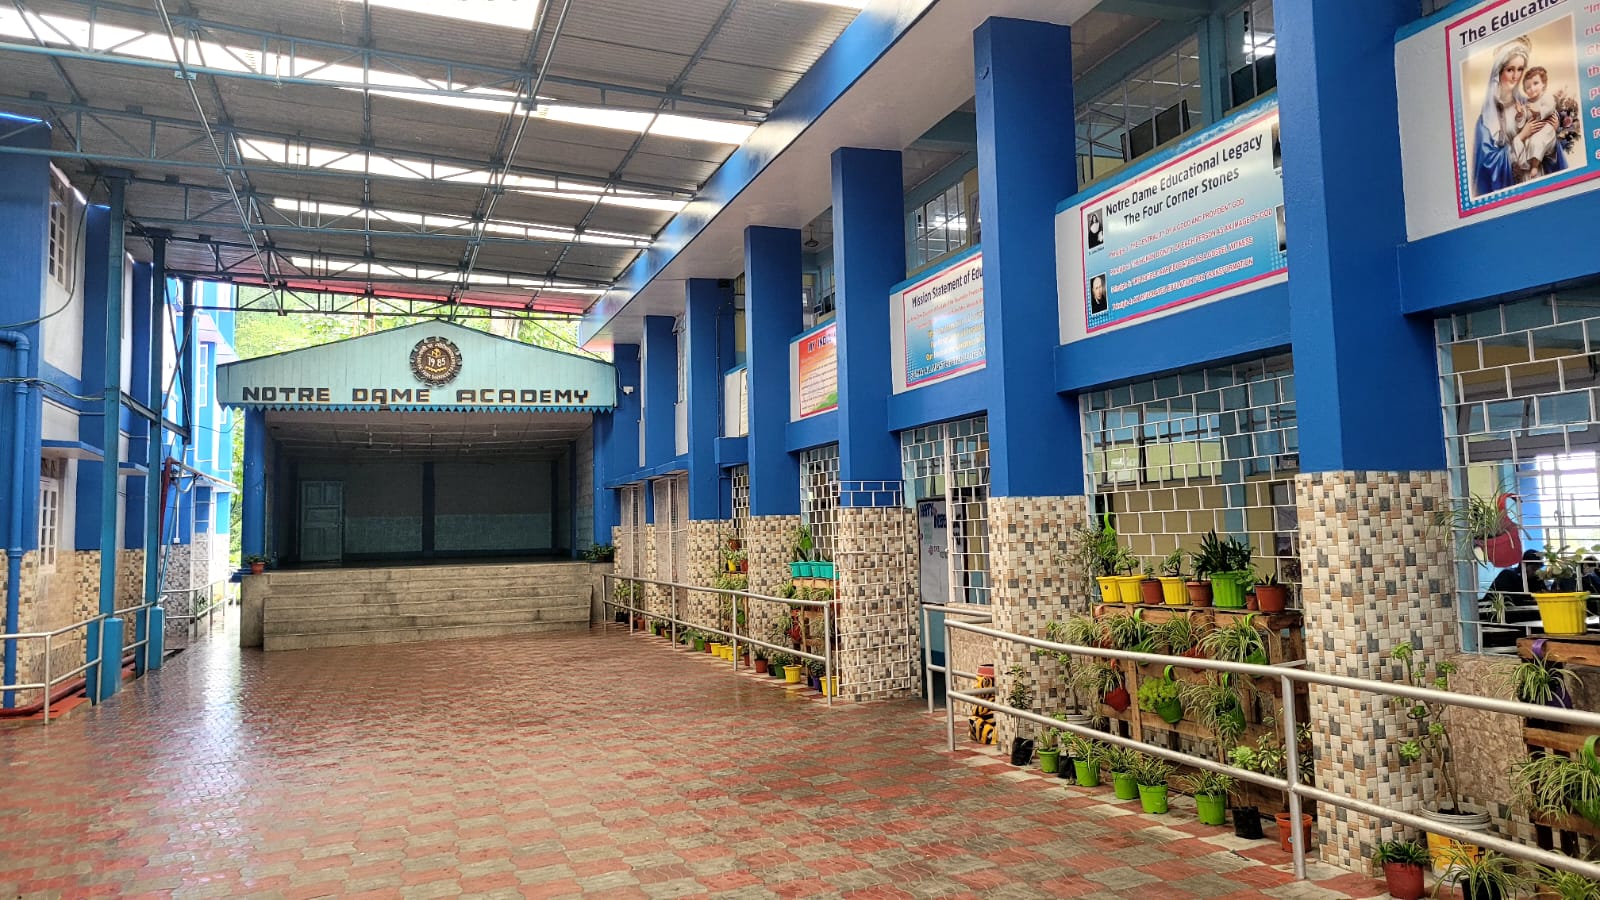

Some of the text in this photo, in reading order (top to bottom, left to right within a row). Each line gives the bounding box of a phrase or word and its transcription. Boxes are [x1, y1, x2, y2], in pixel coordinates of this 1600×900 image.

[1459, 0, 1562, 45] The Educati
[1106, 133, 1262, 216] Notre Dame Educational Legacy
[1124, 168, 1240, 226] The Four Corner Stones
[1202, 202, 1231, 223] PROVIDENT
[1231, 197, 1245, 212] GOD
[1260, 208, 1273, 221] GOD
[911, 290, 932, 309] Mission
[932, 275, 962, 299] Statement
[964, 270, 970, 285] of
[428, 357, 446, 367] 1985
[243, 387, 588, 404] NOTRE DAME ACADEMY
